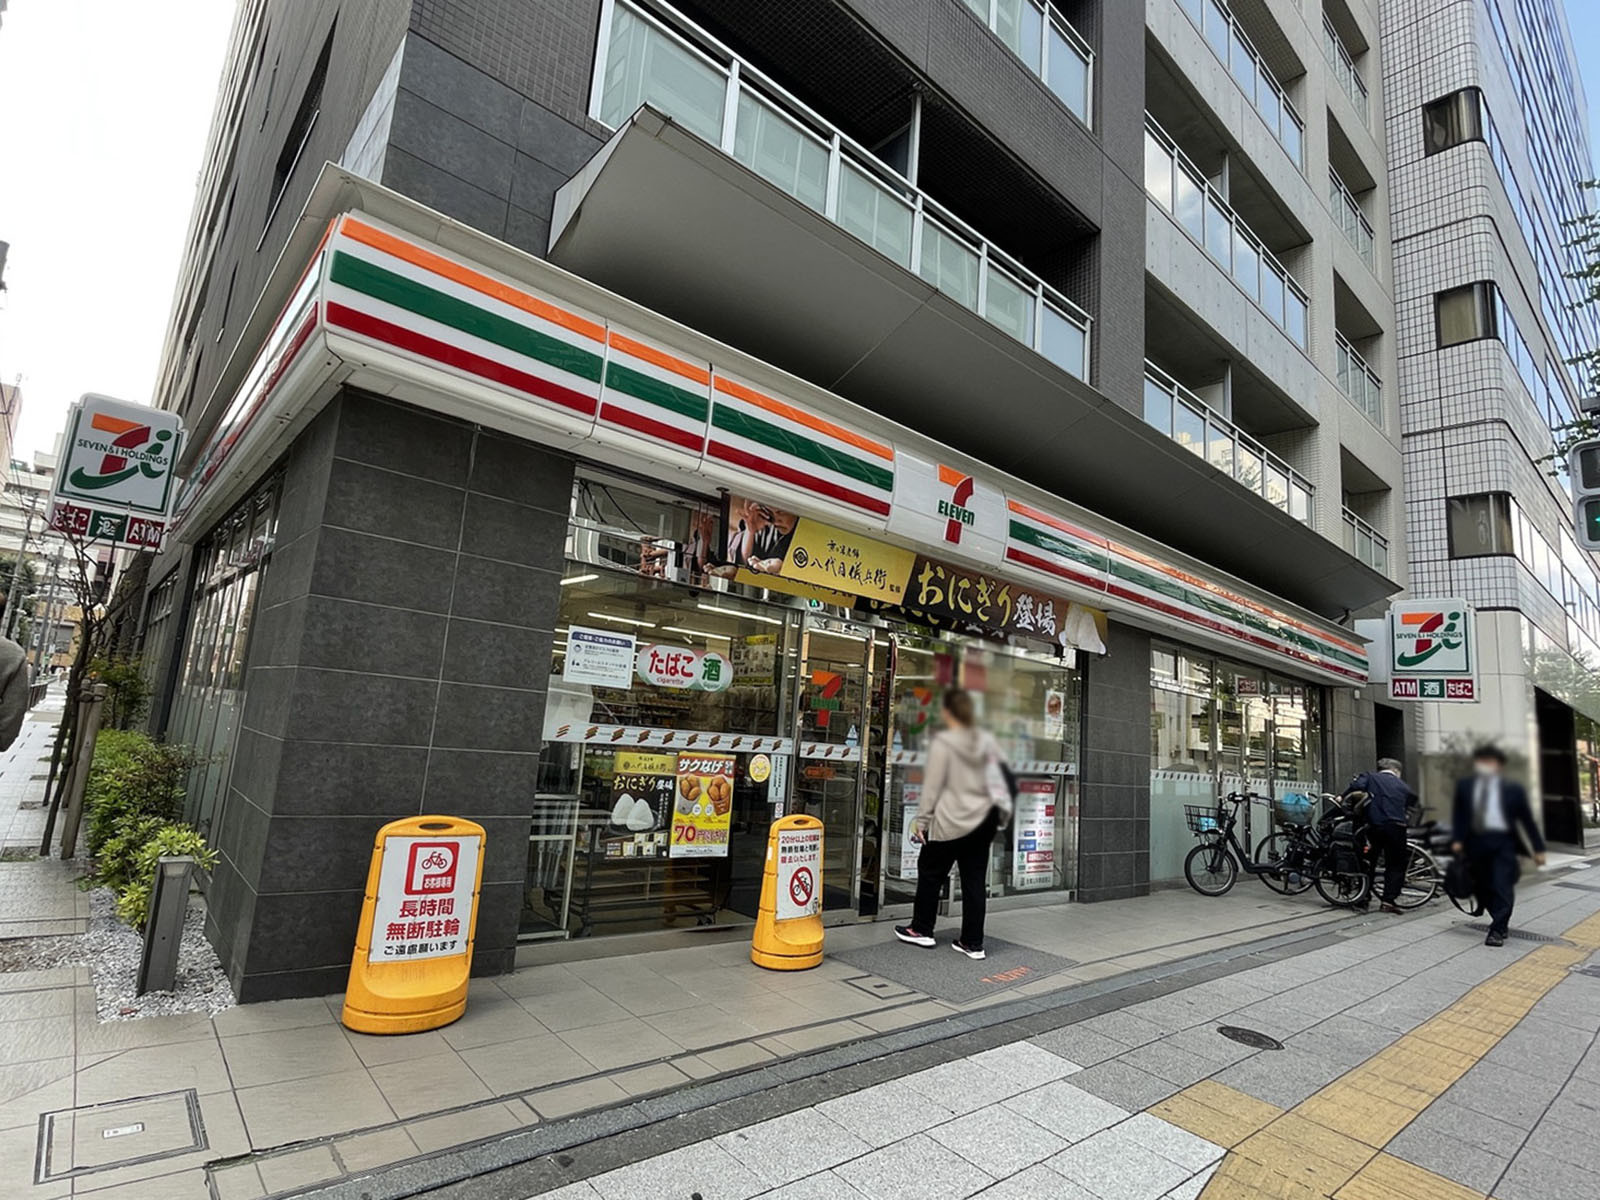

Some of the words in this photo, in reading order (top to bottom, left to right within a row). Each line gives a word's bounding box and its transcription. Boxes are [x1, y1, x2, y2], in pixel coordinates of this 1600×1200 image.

[121, 448, 168, 465] HOLDINGS
[129, 522, 162, 543] ATM
[649, 650, 694, 677] たばこ
[702, 657, 721, 682] 酒
[1393, 681, 1416, 695] ATM
[1423, 682, 1440, 695] 酒
[1447, 682, 1473, 696] たばこ
[399, 898, 454, 918] 長時間
[386, 918, 460, 940] 無断駐輪
[384, 940, 457, 955] ご遠慮願います
